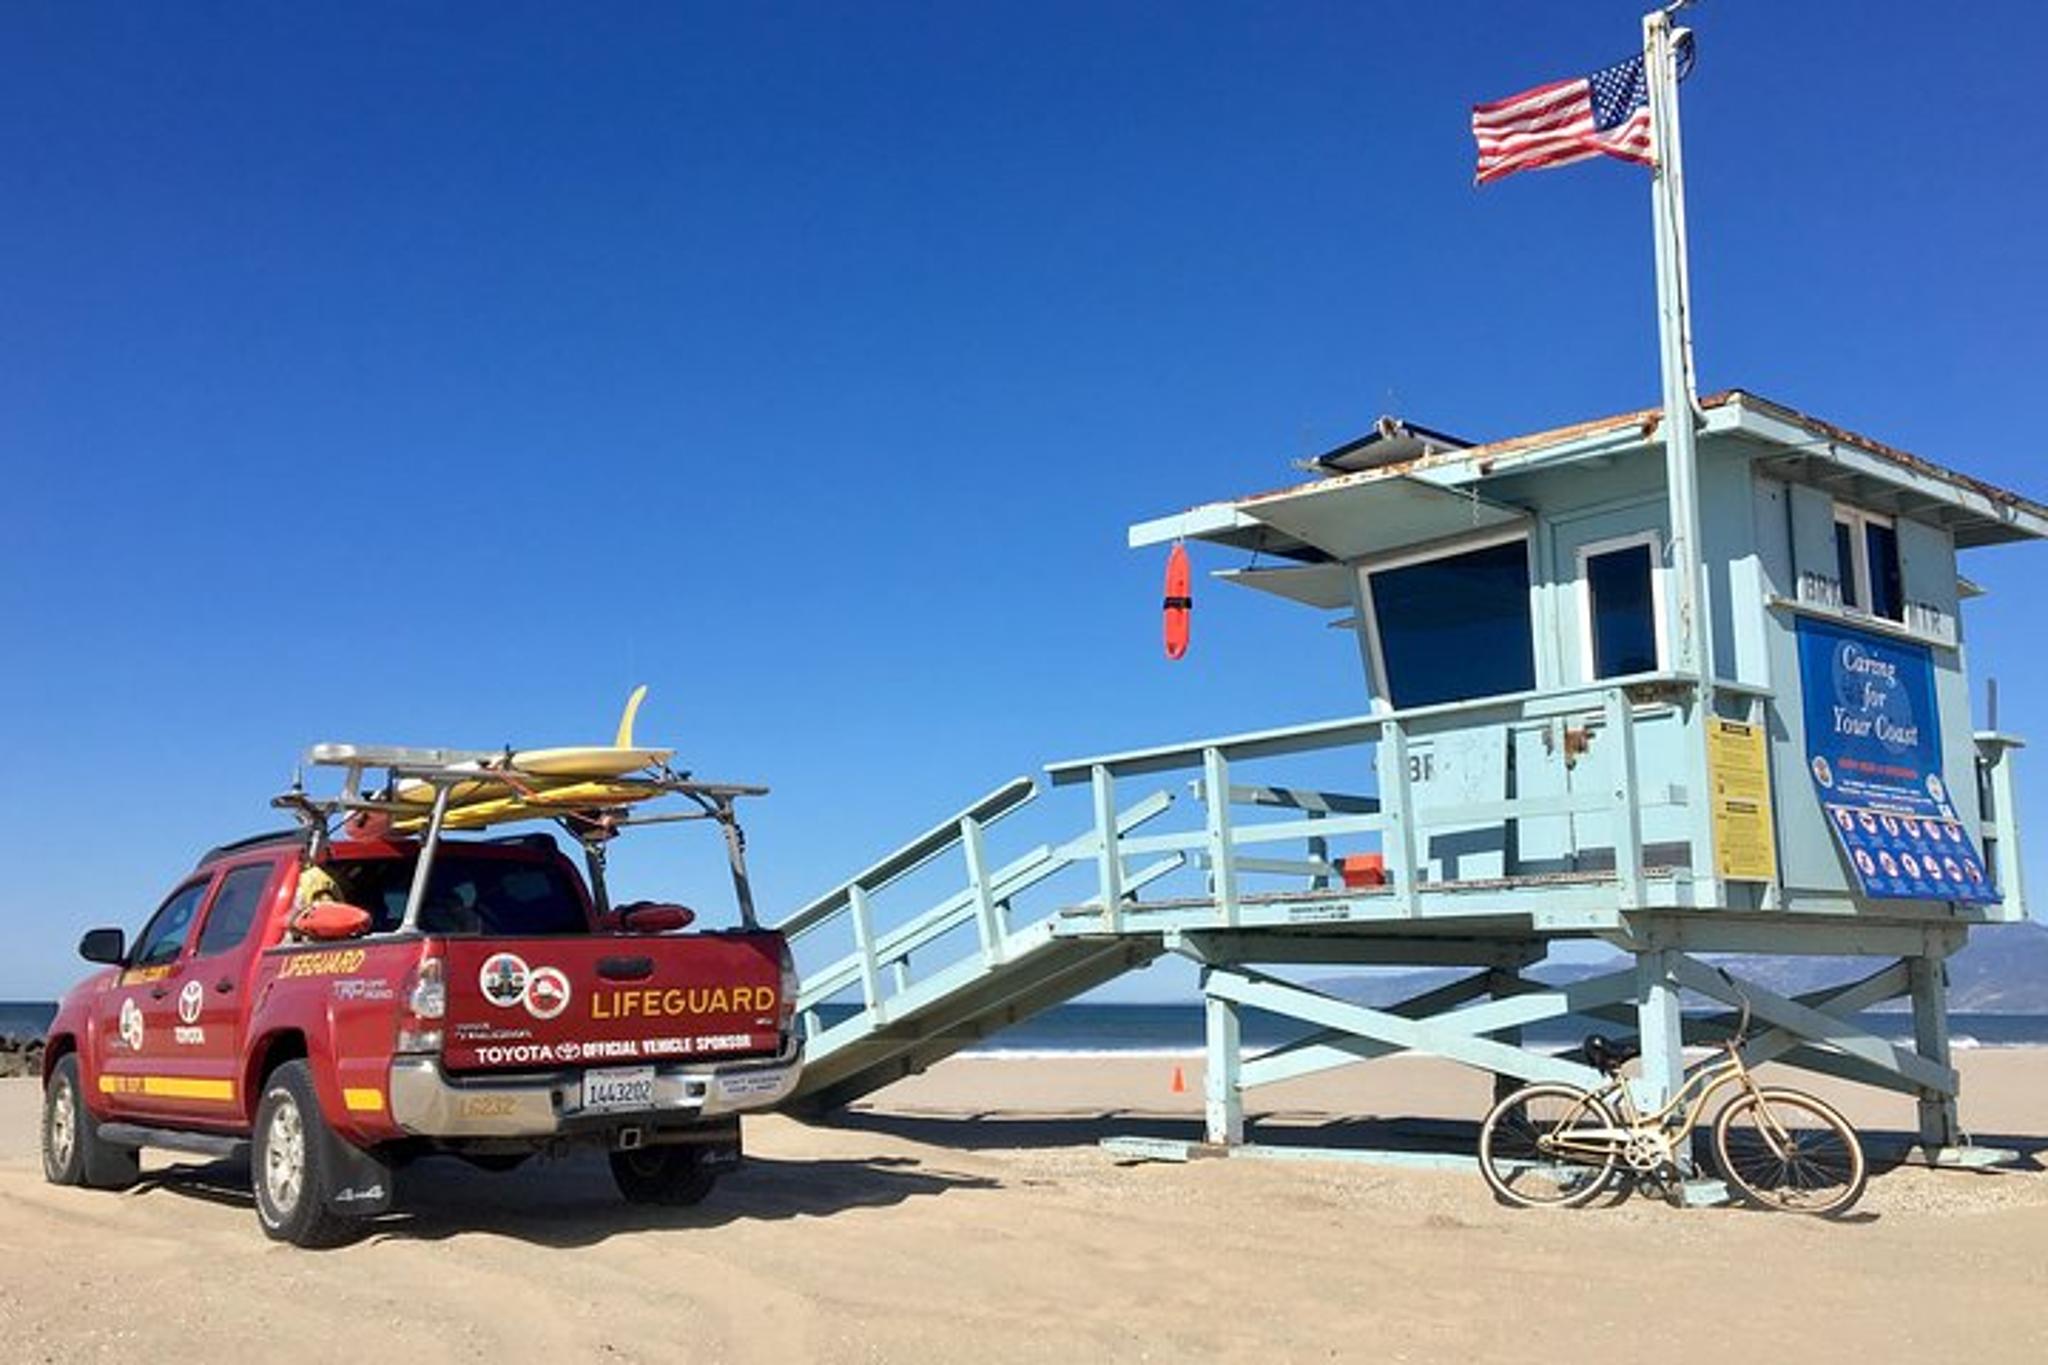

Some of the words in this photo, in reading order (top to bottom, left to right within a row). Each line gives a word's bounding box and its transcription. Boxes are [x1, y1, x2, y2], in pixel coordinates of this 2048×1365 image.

[1843, 645, 1897, 689] Caring
[1860, 681, 1887, 713] for
[1833, 704, 1872, 736] Your
[1875, 714, 1919, 747] Coast
[277, 949, 366, 979] LIFEGUARD
[591, 986, 775, 1019] LIFEGUARD
[474, 1045, 554, 1064] TOYOTA
[582, 1040, 638, 1058] OFFICIAL
[642, 1037, 692, 1053] VEHICLE
[696, 1034, 752, 1051] SPONSOR
